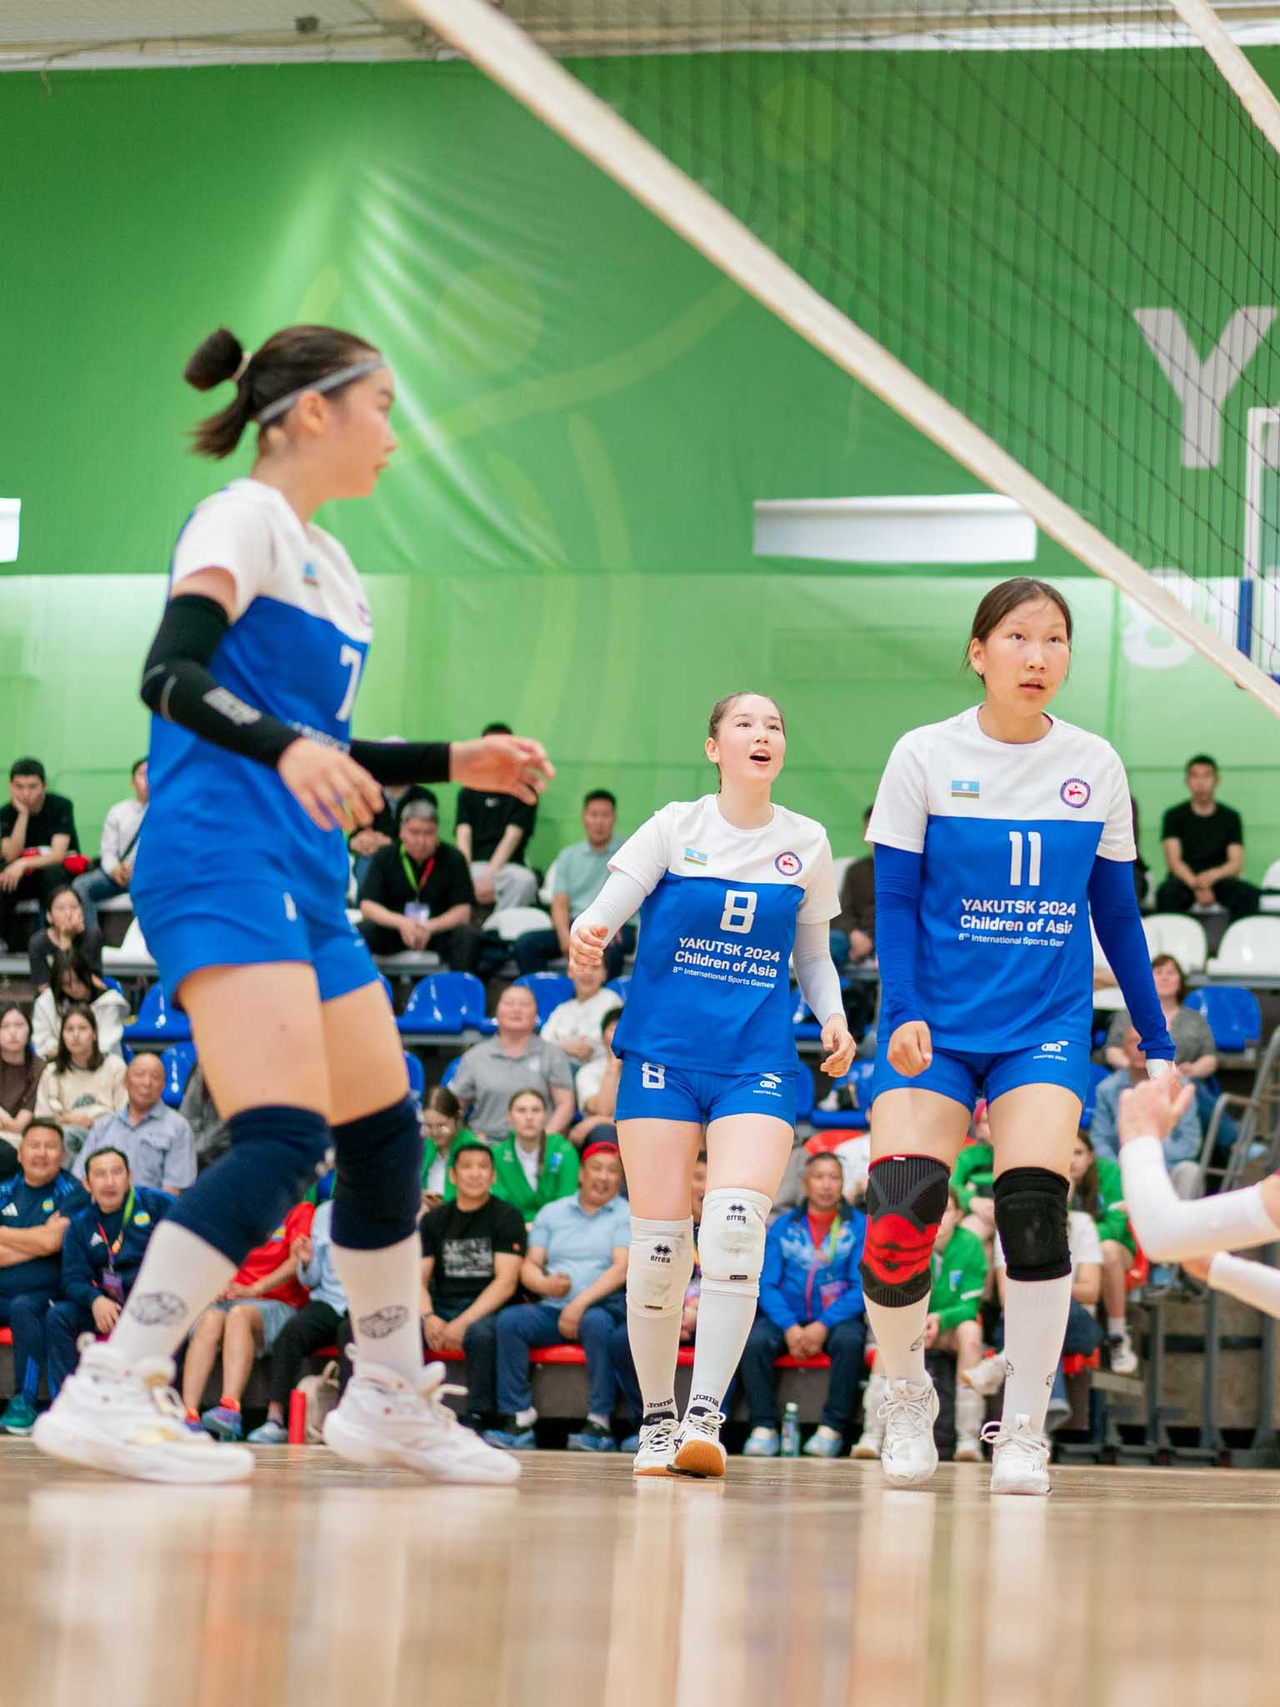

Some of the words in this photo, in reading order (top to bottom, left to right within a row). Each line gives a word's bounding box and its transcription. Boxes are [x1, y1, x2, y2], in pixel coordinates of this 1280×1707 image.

[335, 643, 362, 722] 7
[1008, 831, 1041, 886] 11
[720, 889, 757, 934] 8
[961, 898, 1036, 914] YAKUTSK
[1038, 900, 1077, 916] 2024
[960, 914, 1023, 932] Children
[1026, 918, 1044, 932] of
[679, 937, 743, 957] YAKUTSK
[743, 946, 781, 963] 2024
[971, 933, 1021, 945] International
[1022, 936, 1048, 947] Sports
[674, 950, 730, 971] Children
[732, 961, 748, 973] of
[747, 963, 778, 978] Asia
[683, 967, 727, 981] International
[727, 975, 750, 985] Sports
[750, 979, 775, 989] Games
[642, 1062, 665, 1089] 8
